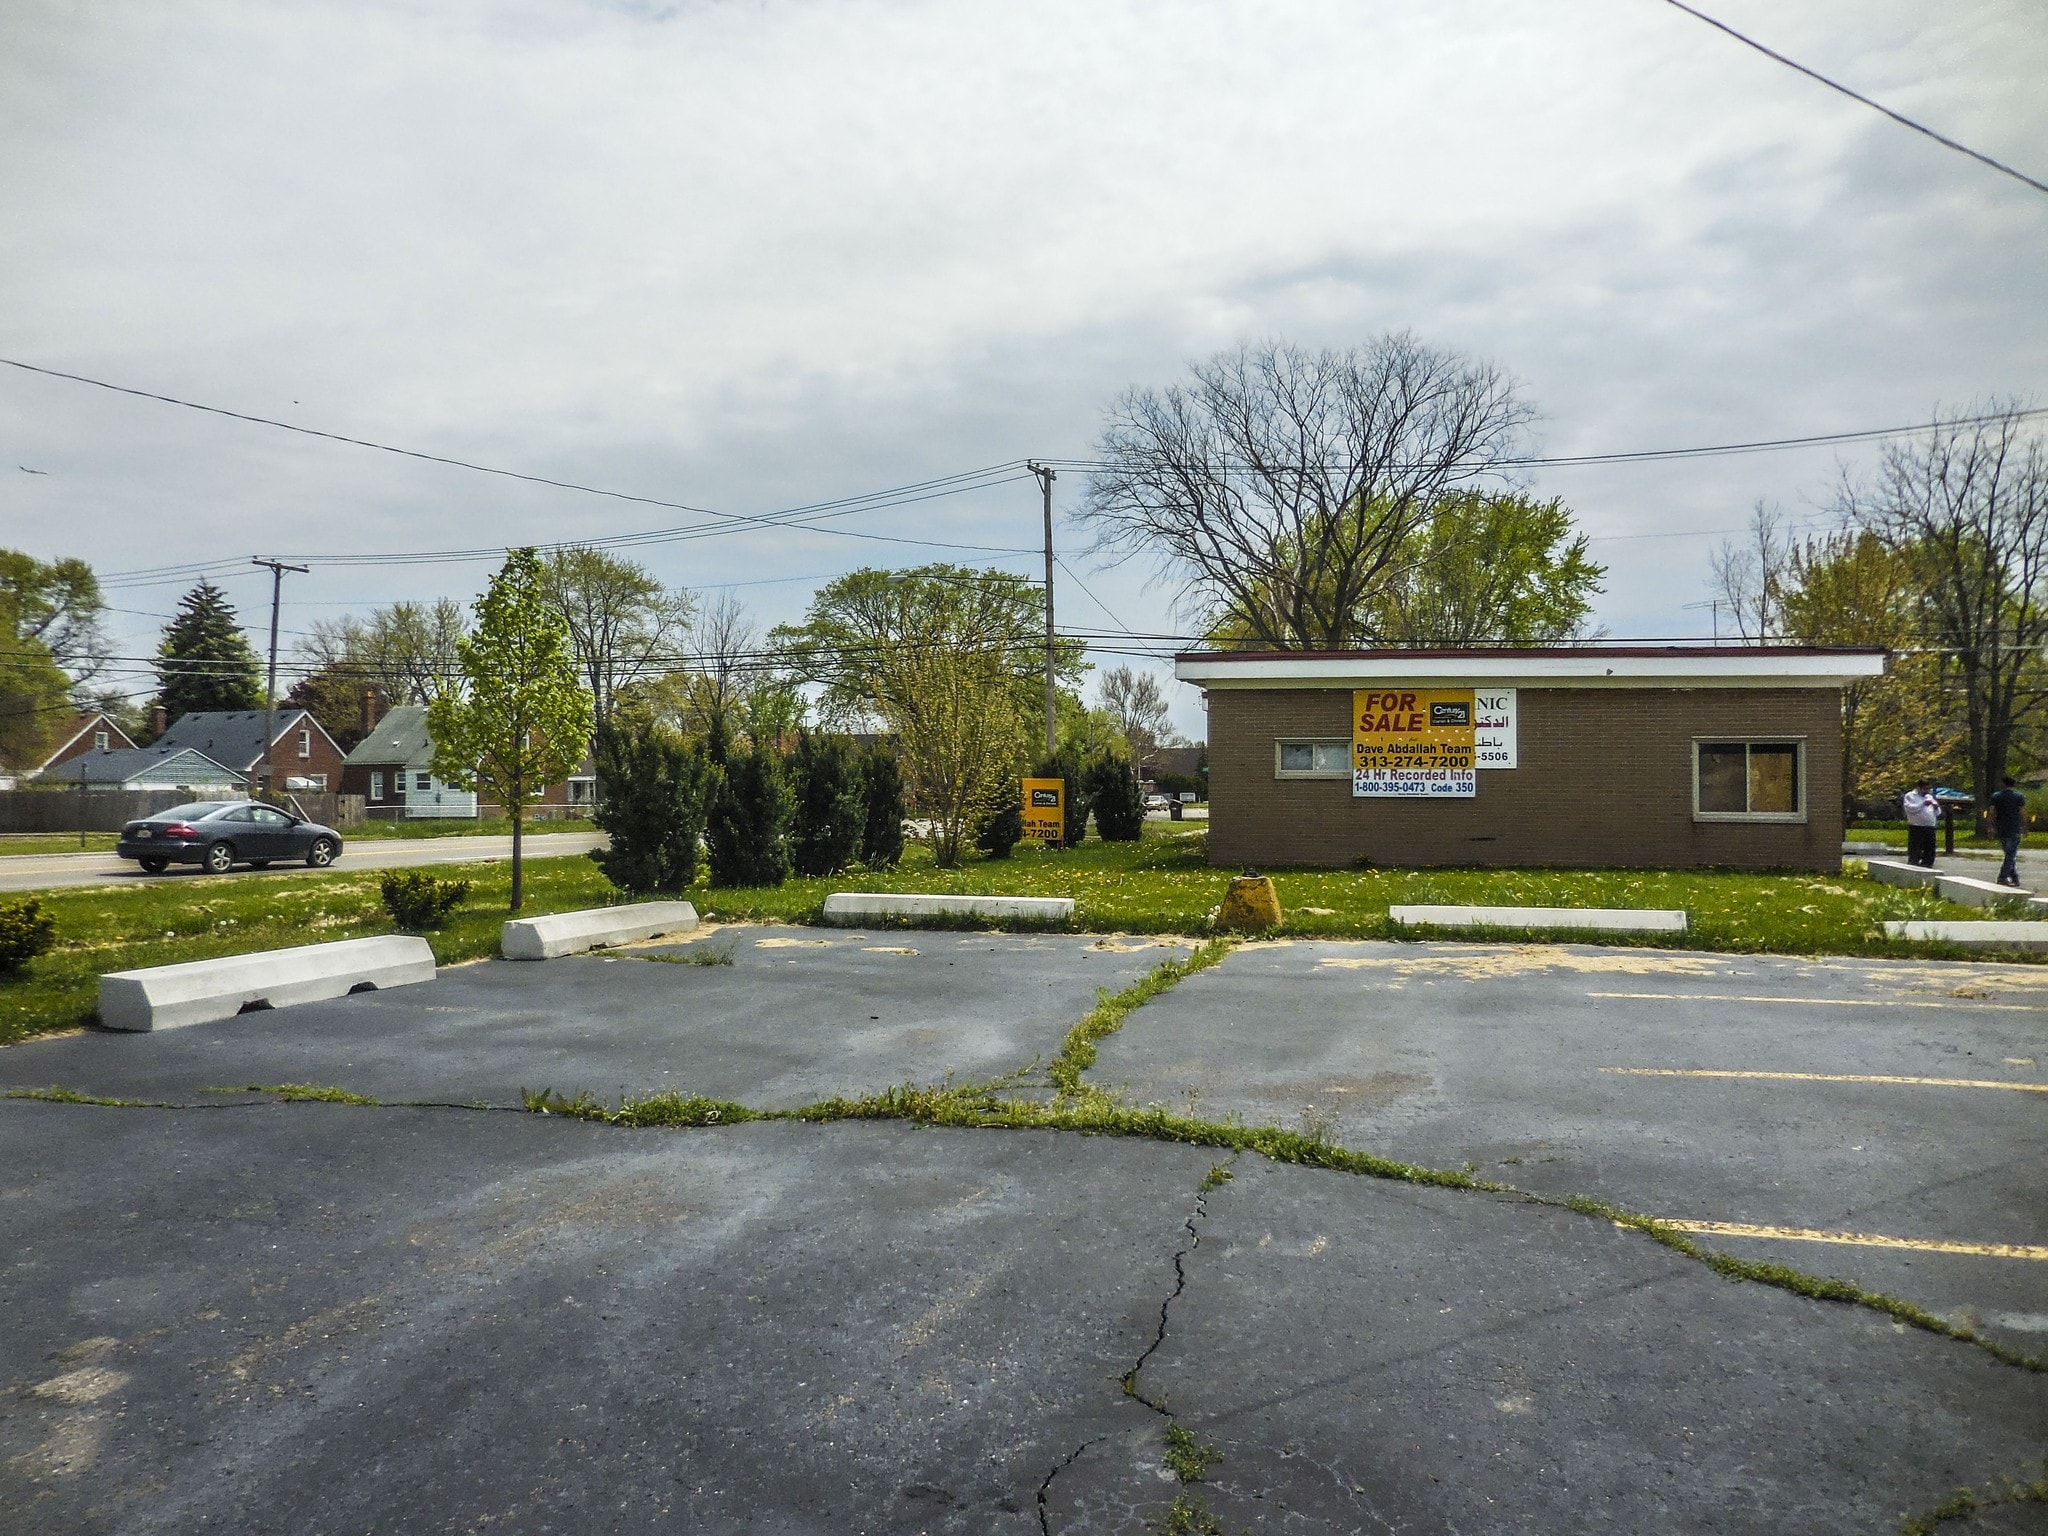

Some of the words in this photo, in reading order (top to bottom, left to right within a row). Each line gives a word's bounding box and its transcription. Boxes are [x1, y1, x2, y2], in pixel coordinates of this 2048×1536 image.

[1366, 693, 1416, 712] FOR
[1477, 697, 1508, 710] NIC
[1360, 713, 1423, 732] SALE
[1357, 744, 1383, 754] Dave
[1387, 744, 1436, 754] Abdallah
[1440, 744, 1471, 754] Team
[1360, 756, 1469, 767] 313-274-7200
[1475, 752, 1508, 761] -5506
[1355, 769, 1370, 780] 24
[1373, 769, 1387, 780] Hr
[1390, 769, 1446, 780] Recorded
[1450, 769, 1473, 780] Info
[1354, 782, 1426, 792] 1-800-395-0473
[1431, 783, 1453, 792] Code
[1455, 782, 1474, 792] 350
[1038, 820, 1060, 828] Team
